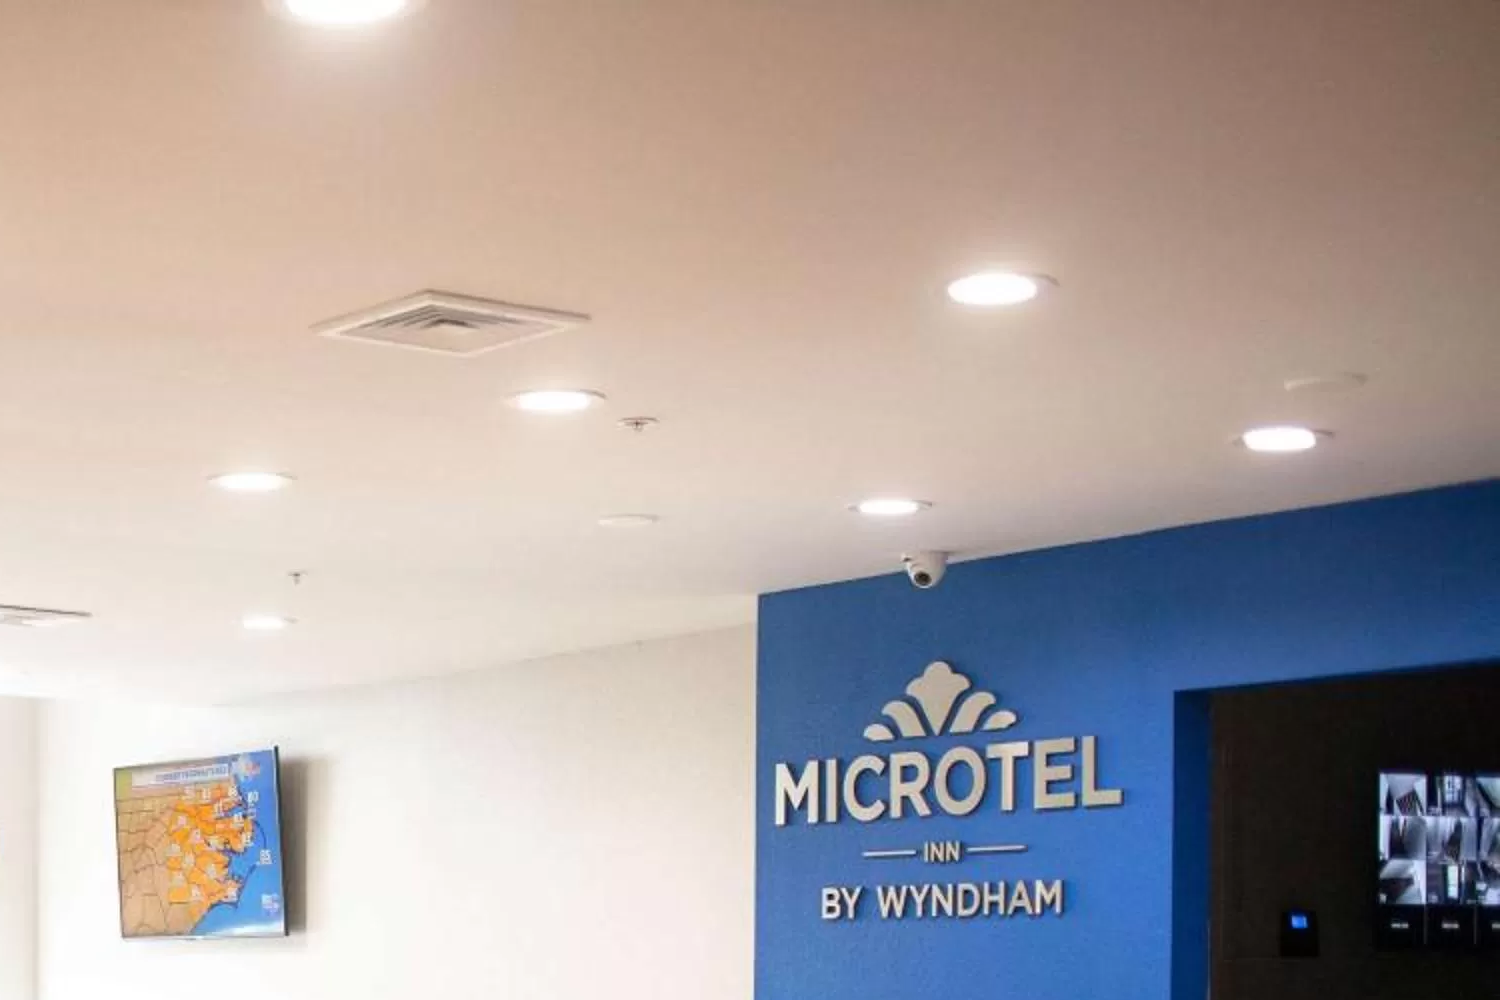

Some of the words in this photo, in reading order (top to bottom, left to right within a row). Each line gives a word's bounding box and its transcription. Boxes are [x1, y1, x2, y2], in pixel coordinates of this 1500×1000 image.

[775, 736, 1123, 826] MICROTEL
[922, 841, 961, 863] INN
[820, 886, 864, 920] BY
[876, 879, 1063, 918] WYNDHAM
